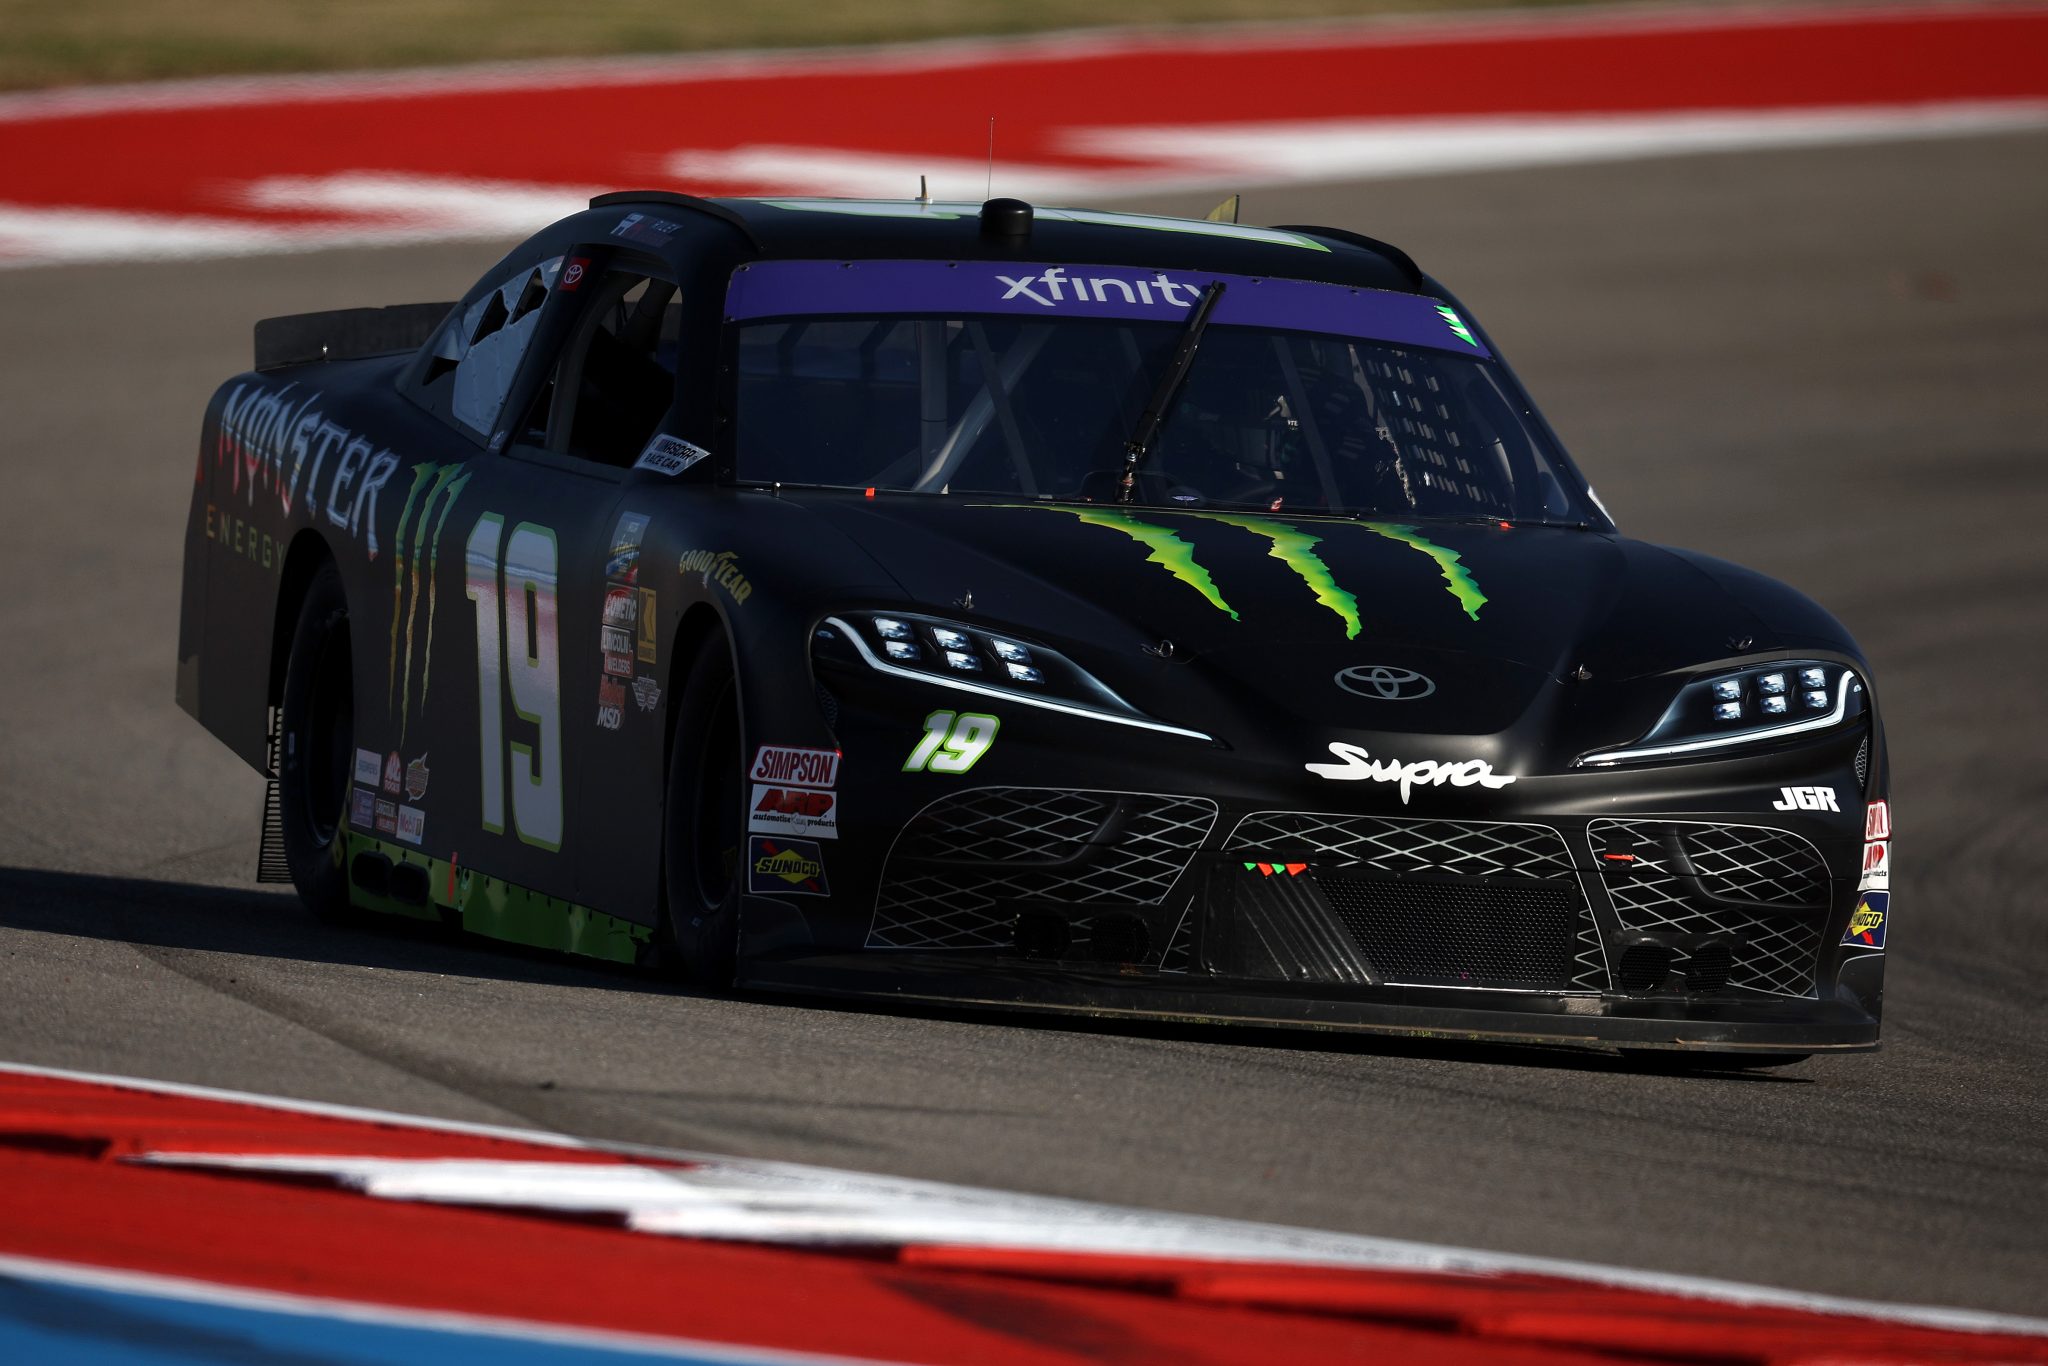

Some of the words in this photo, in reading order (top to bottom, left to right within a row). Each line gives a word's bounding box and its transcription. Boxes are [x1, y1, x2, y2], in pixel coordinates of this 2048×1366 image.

[218, 380, 400, 561] MONSTER
[661, 458, 681, 470] CAR
[205, 504, 284, 575] ENERGY
[679, 549, 753, 606] GOODYEAR
[605, 594, 637, 621] COMETIC
[602, 632, 630, 654] LINCOLN
[466, 511, 563, 853] 19
[596, 706, 622, 731] MSD
[902, 710, 1000, 774] 19
[756, 749, 834, 784] SIMPSON
[1305, 742, 1517, 805] Supra
[754, 788, 834, 817] ARP
[1772, 786, 1841, 813] JGR
[752, 813, 791, 824] automotive
[807, 818, 835, 828] products
[758, 857, 819, 876] SUNOCO
